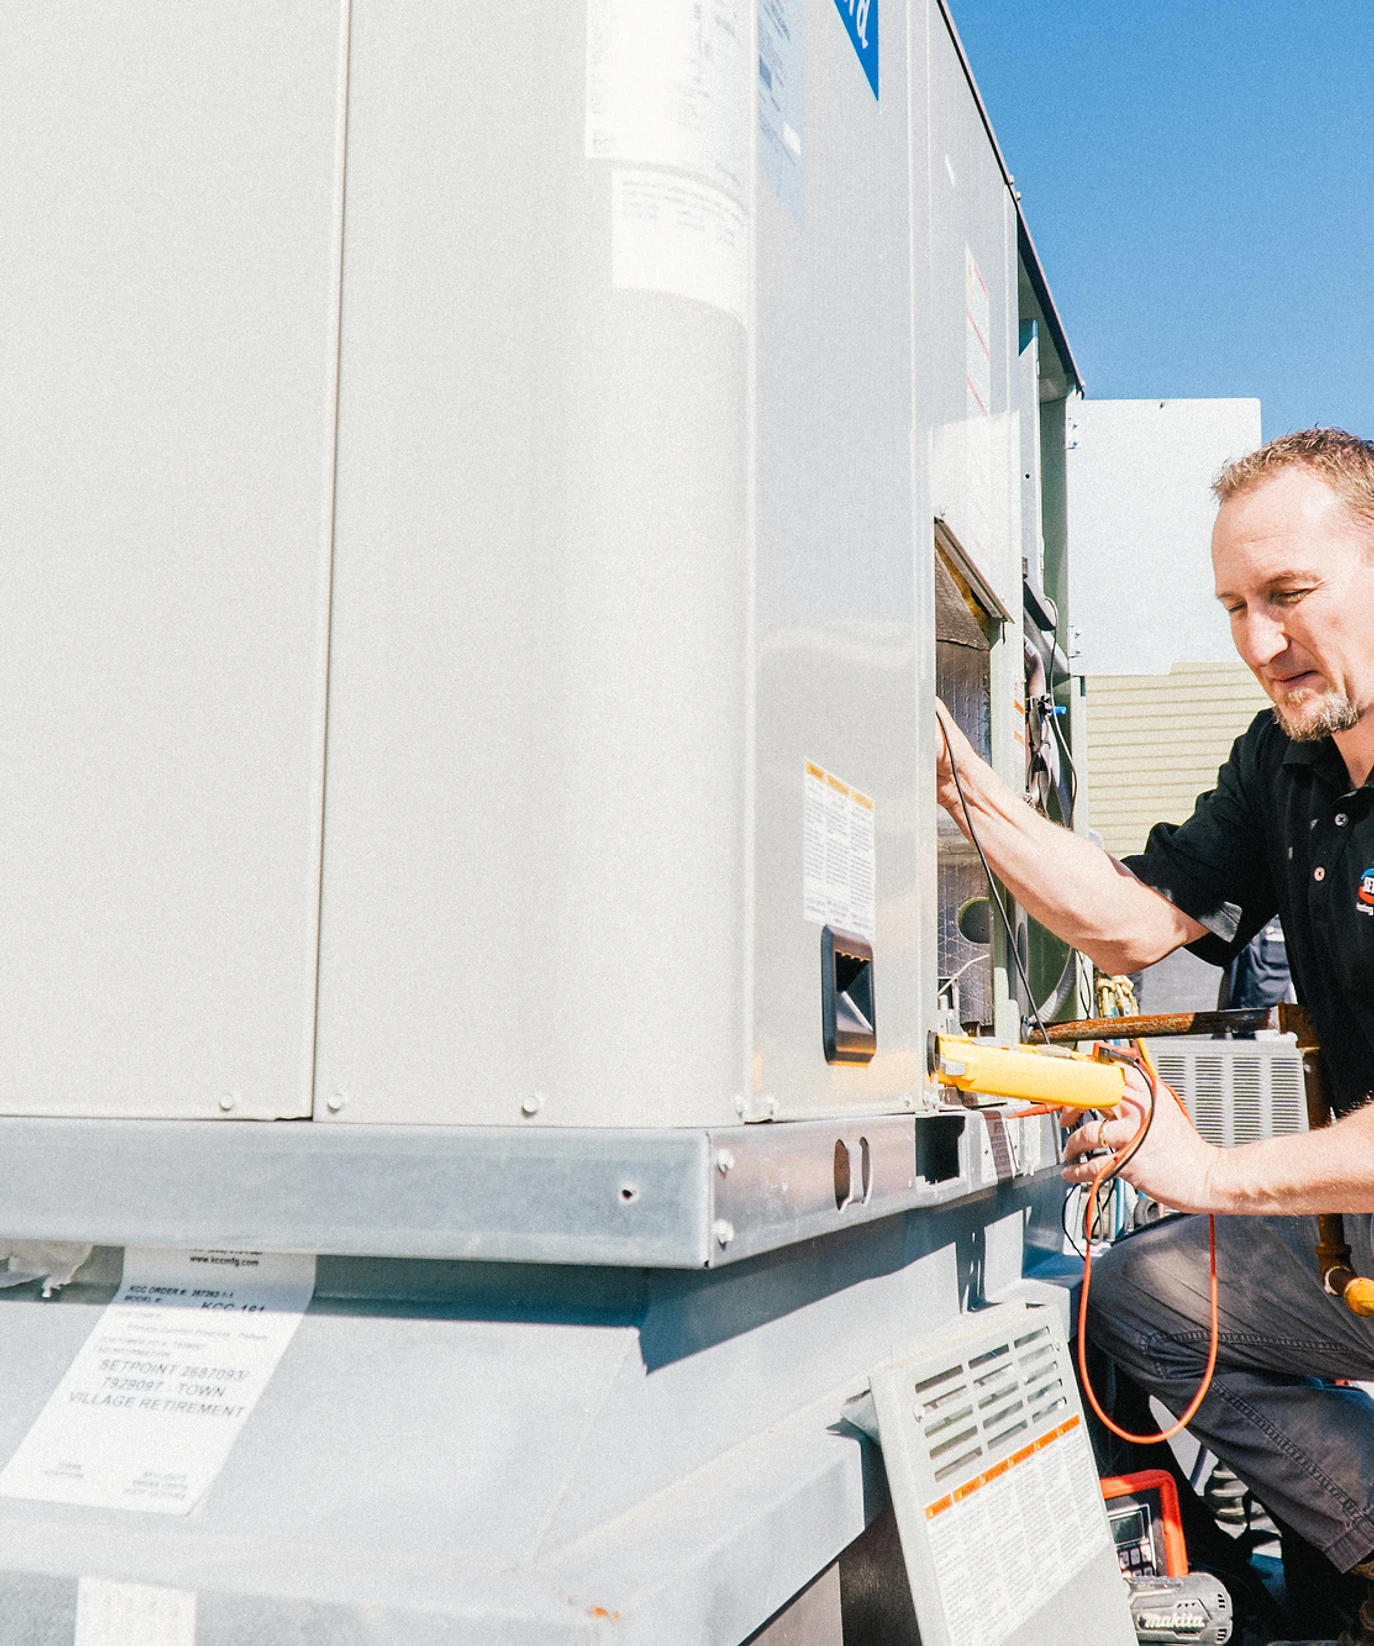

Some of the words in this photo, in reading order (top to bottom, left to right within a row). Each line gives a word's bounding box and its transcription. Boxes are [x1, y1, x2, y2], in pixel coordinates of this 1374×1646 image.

[99, 1359, 178, 1375] SETPOINT
[178, 1383, 226, 1398] TOWN
[69, 1391, 136, 1409] VILLAGE
[138, 1398, 247, 1418] RETIREMENT
